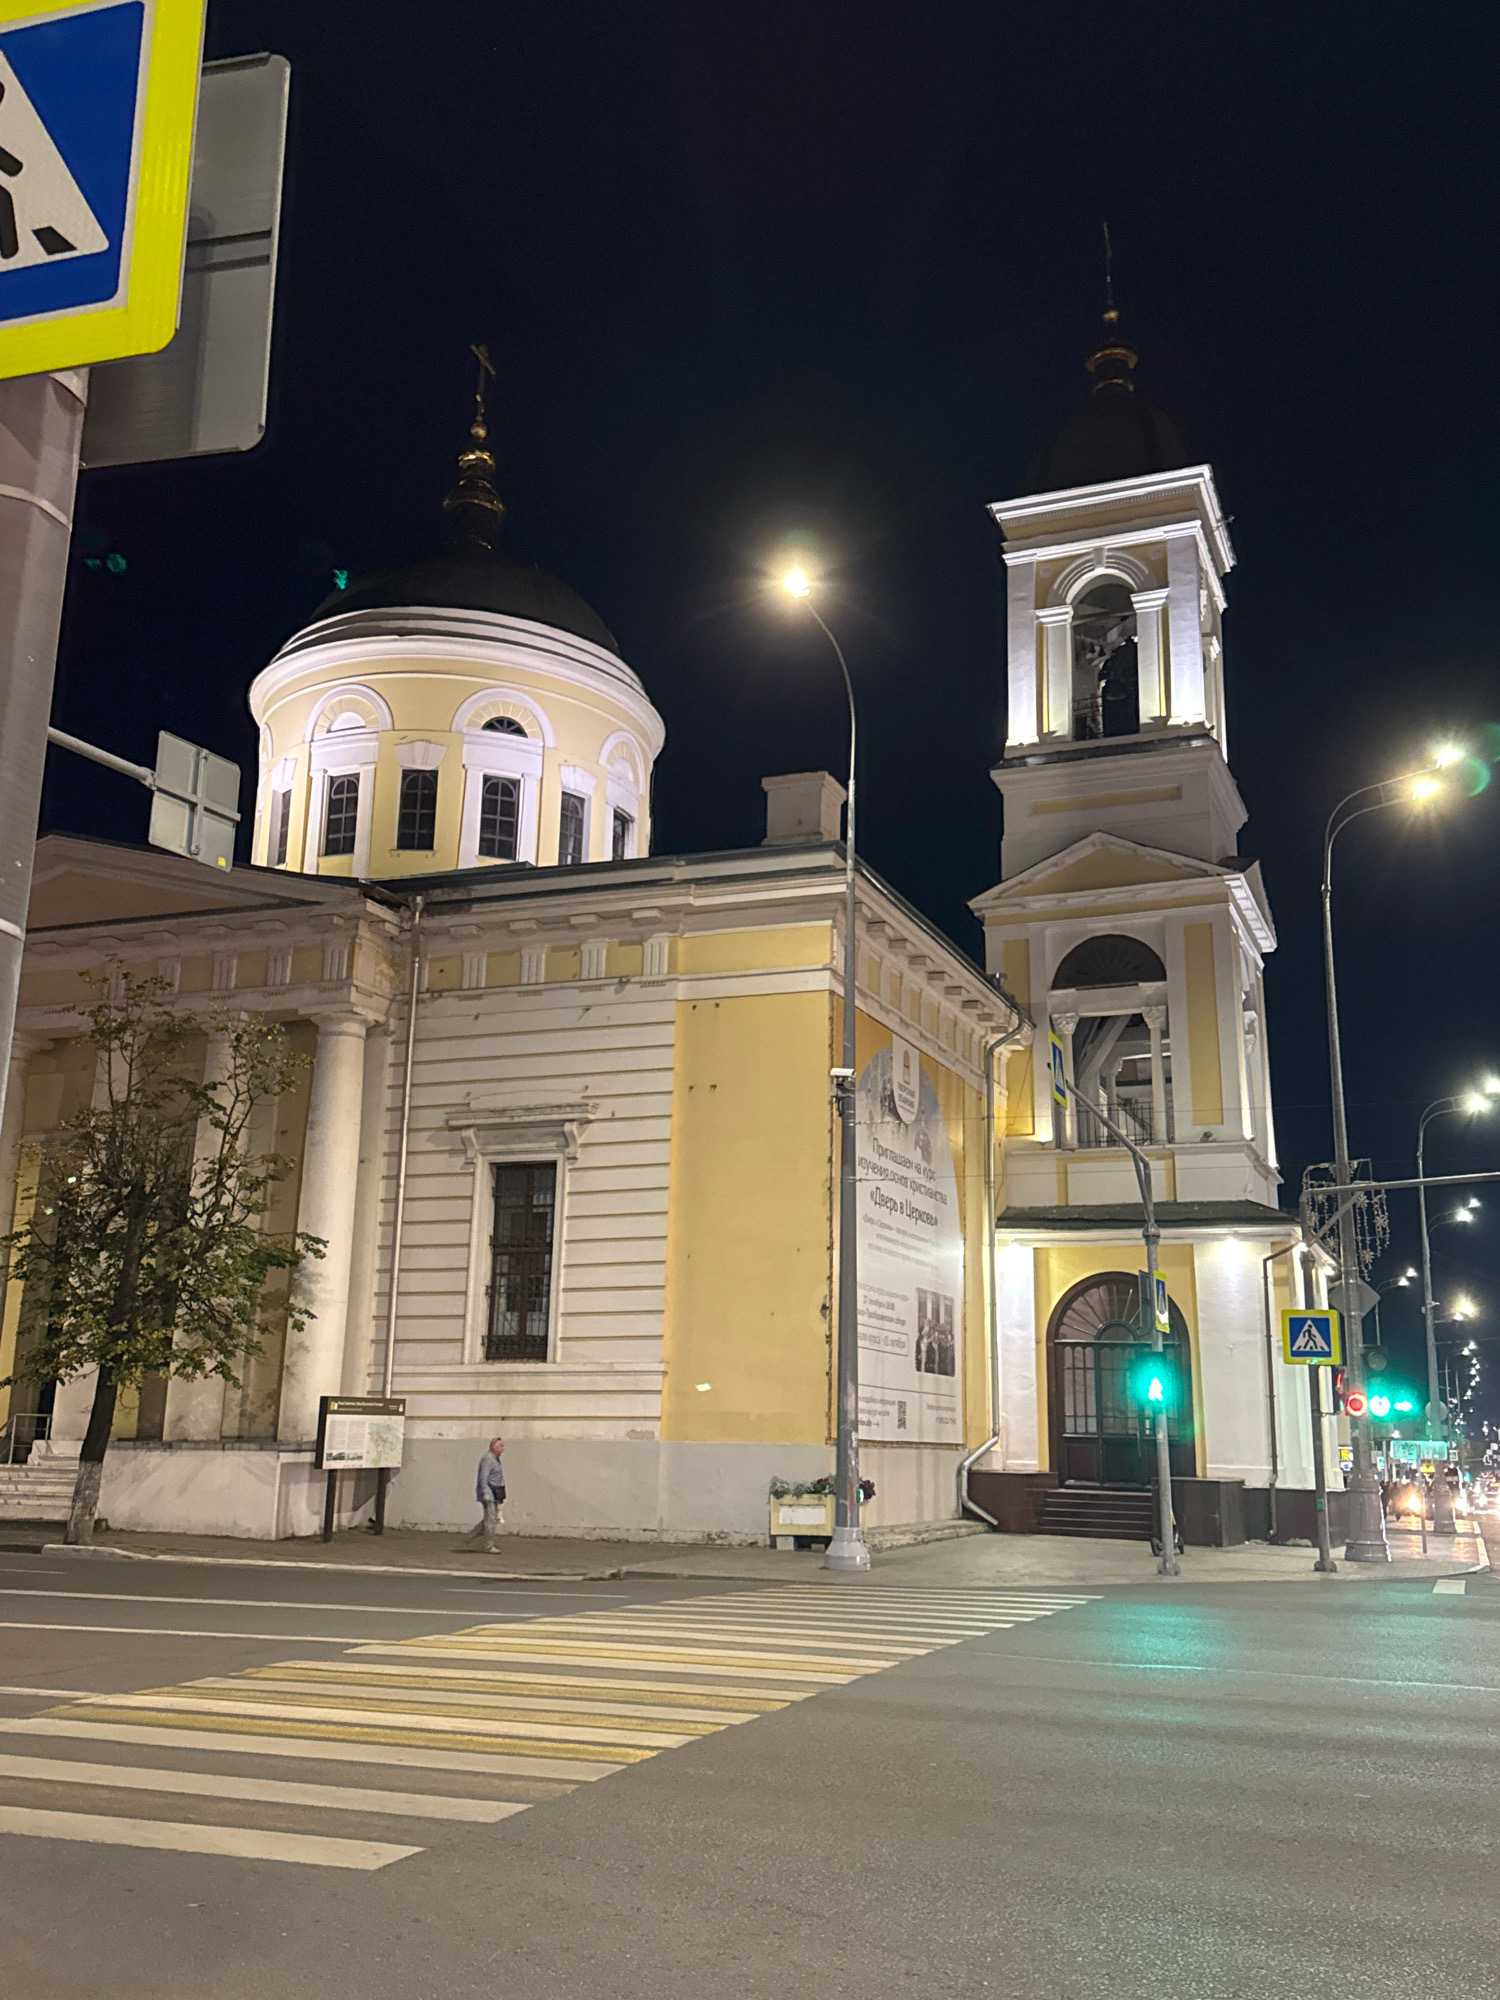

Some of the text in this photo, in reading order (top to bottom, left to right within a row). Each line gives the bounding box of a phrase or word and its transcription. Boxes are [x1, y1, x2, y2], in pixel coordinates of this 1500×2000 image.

[858, 1155, 947, 1205] изучения основ христианства
[873, 1137, 936, 1184] Приглашаем на курс
[870, 1186, 938, 1226] «Дверь в Церковь»
